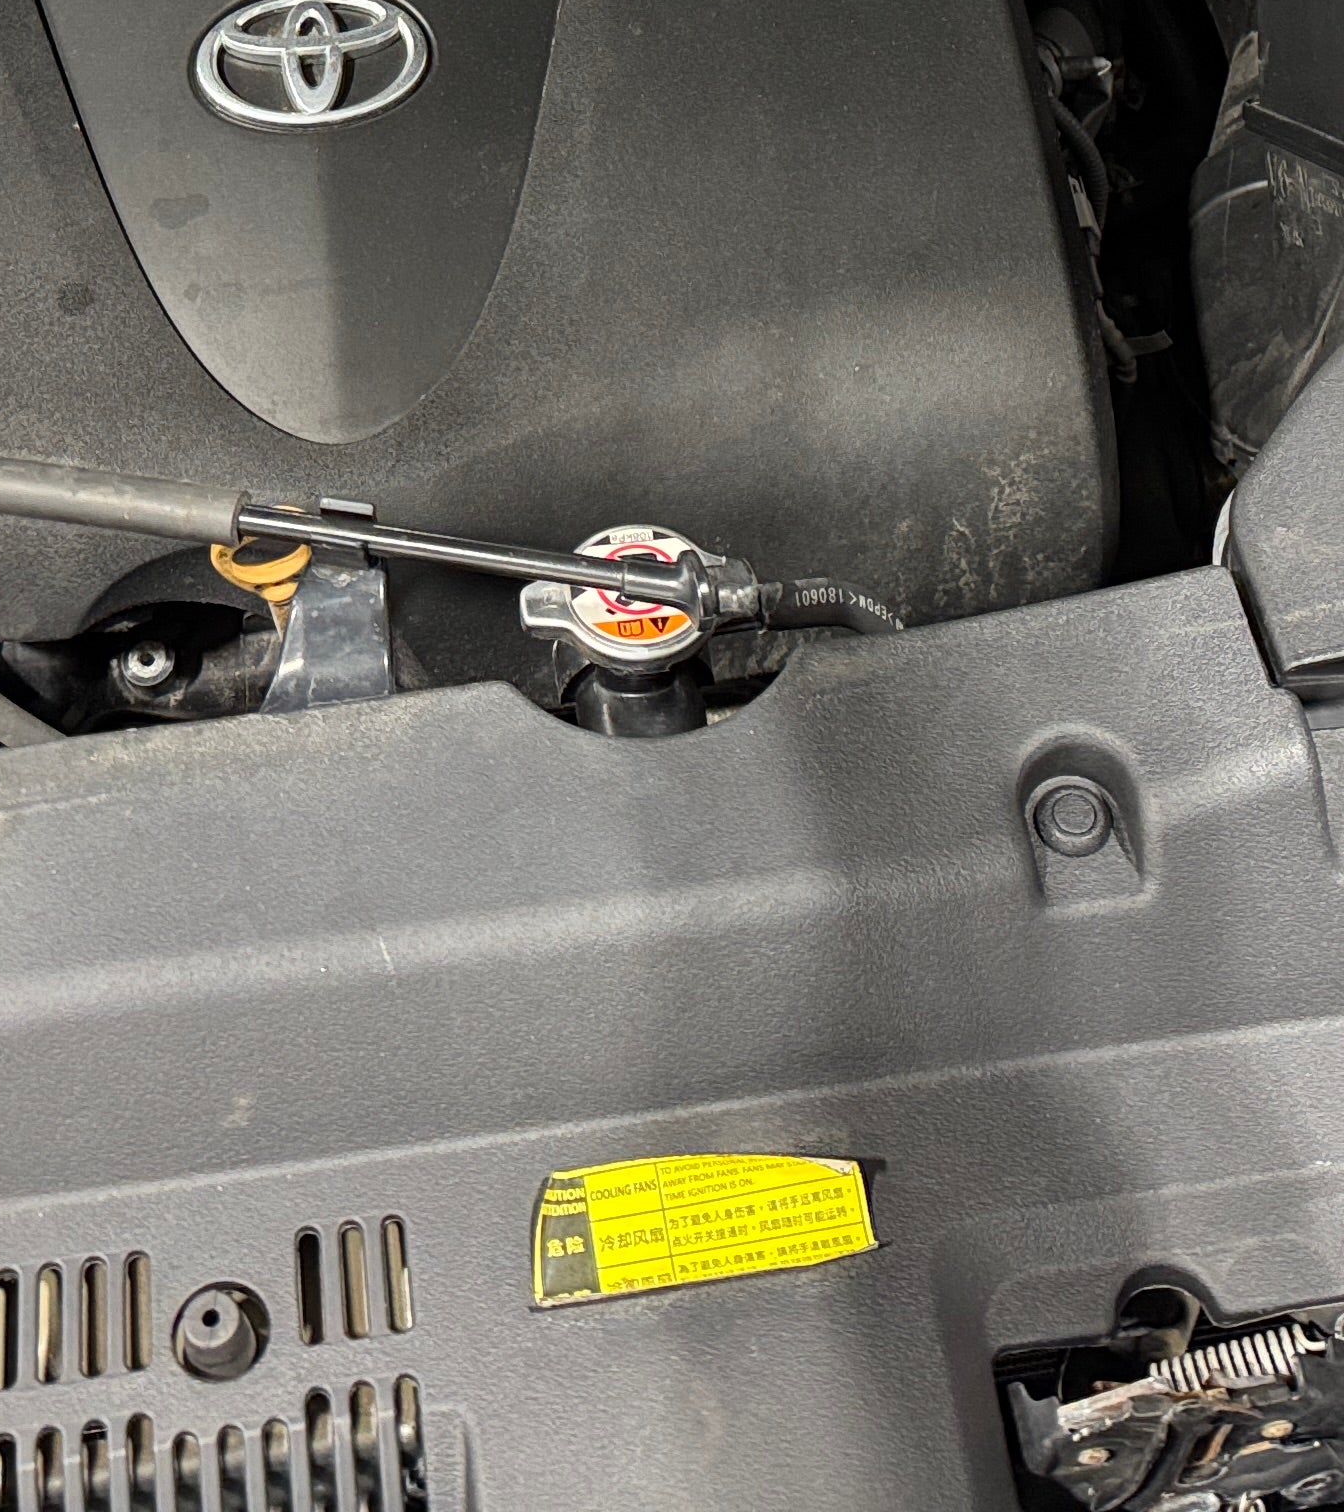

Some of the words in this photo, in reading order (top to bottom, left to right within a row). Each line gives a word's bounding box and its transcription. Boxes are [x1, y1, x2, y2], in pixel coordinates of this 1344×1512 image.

[795, 587, 845, 608] 180601
[688, 1172, 715, 1183] FROM
[590, 1184, 631, 1201] COOLING
[633, 1179, 657, 1194] FANS
[688, 1183, 727, 1197] IGNITION
[546, 1235, 585, 1258] 危险
[599, 1227, 665, 1252] 冷却风扇
